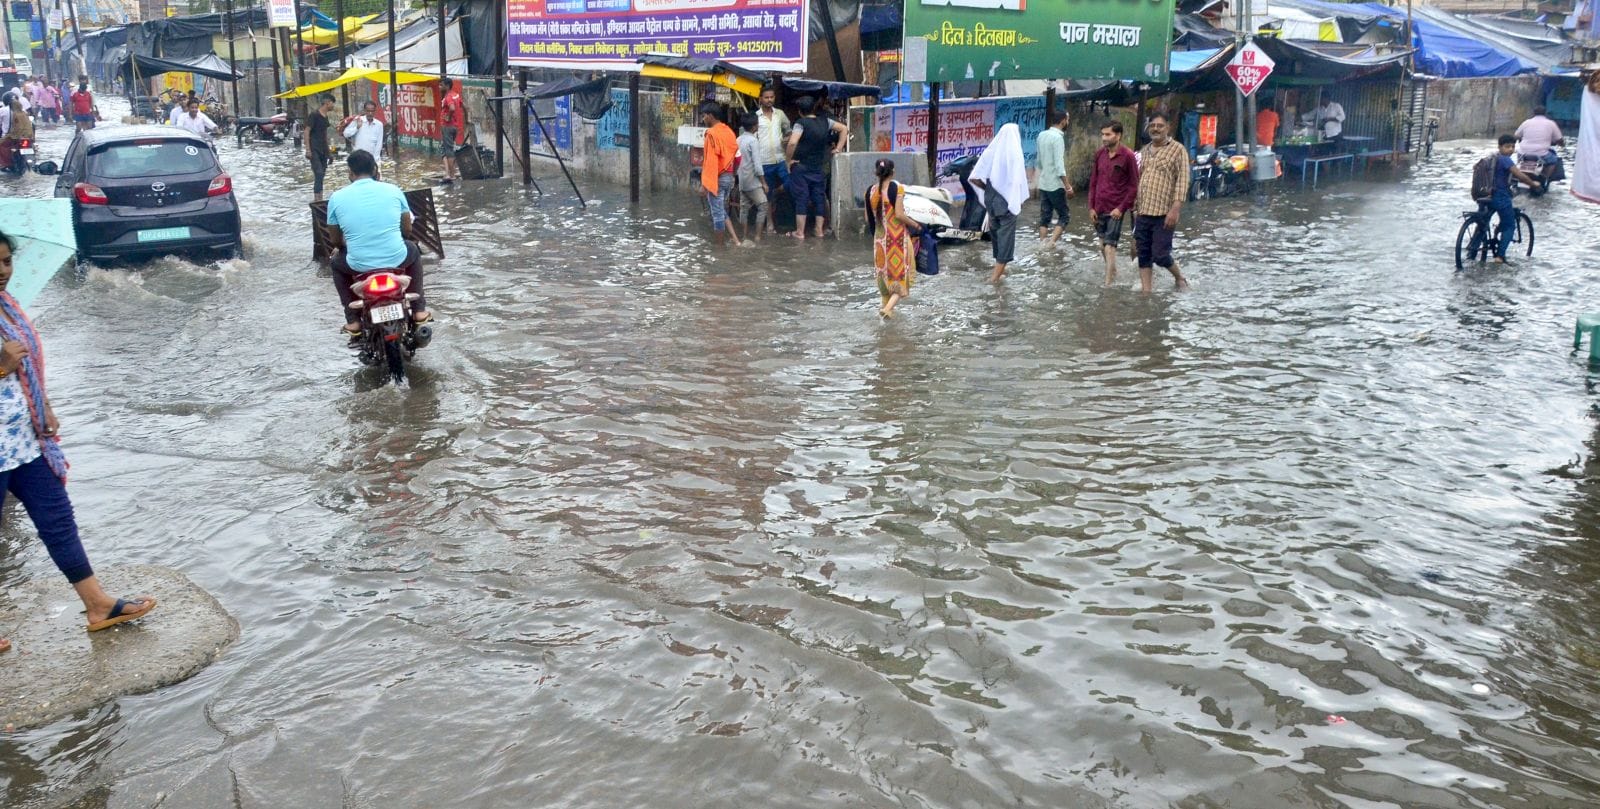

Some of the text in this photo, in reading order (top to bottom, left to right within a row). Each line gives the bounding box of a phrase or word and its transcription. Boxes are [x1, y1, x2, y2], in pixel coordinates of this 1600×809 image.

[585, 20, 590, 34] के
[674, 16, 680, 32] के
[941, 20, 965, 46] दिल
[974, 22, 1016, 47] दिलबाग
[1059, 21, 1141, 47] पान मसाला
[693, 39, 715, 54] सम्पर्क
[737, 40, 783, 53] 9412501711
[1237, 66, 1261, 78] 60%
[1237, 76, 1258, 86] OFF
[946, 110, 984, 125] अस्पताल
[964, 123, 993, 143] क्लीनिक
